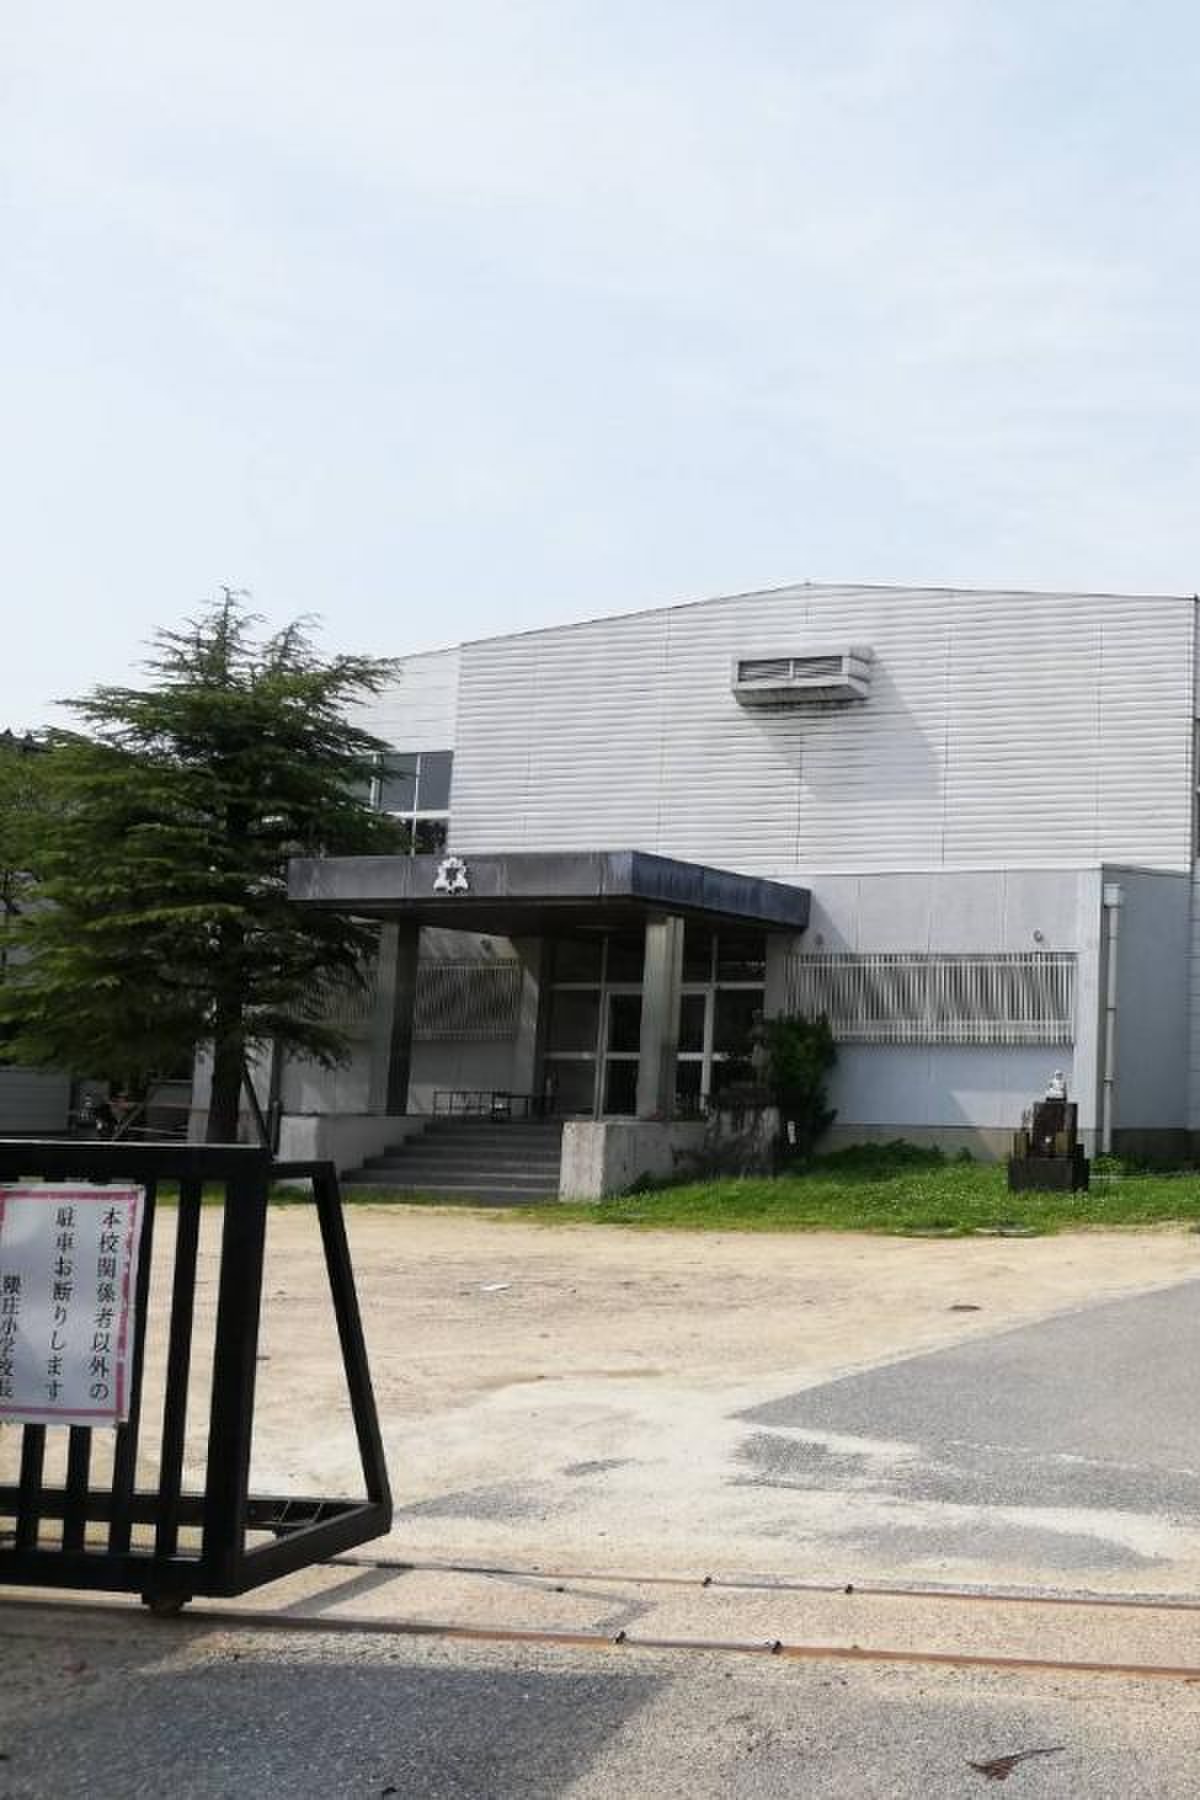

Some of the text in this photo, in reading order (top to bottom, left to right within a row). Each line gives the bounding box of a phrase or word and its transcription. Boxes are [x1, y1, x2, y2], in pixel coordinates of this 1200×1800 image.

[47, 1207, 76, 1402] 駐車お断りします
[88, 1207, 121, 1400] 本校関係者以外の
